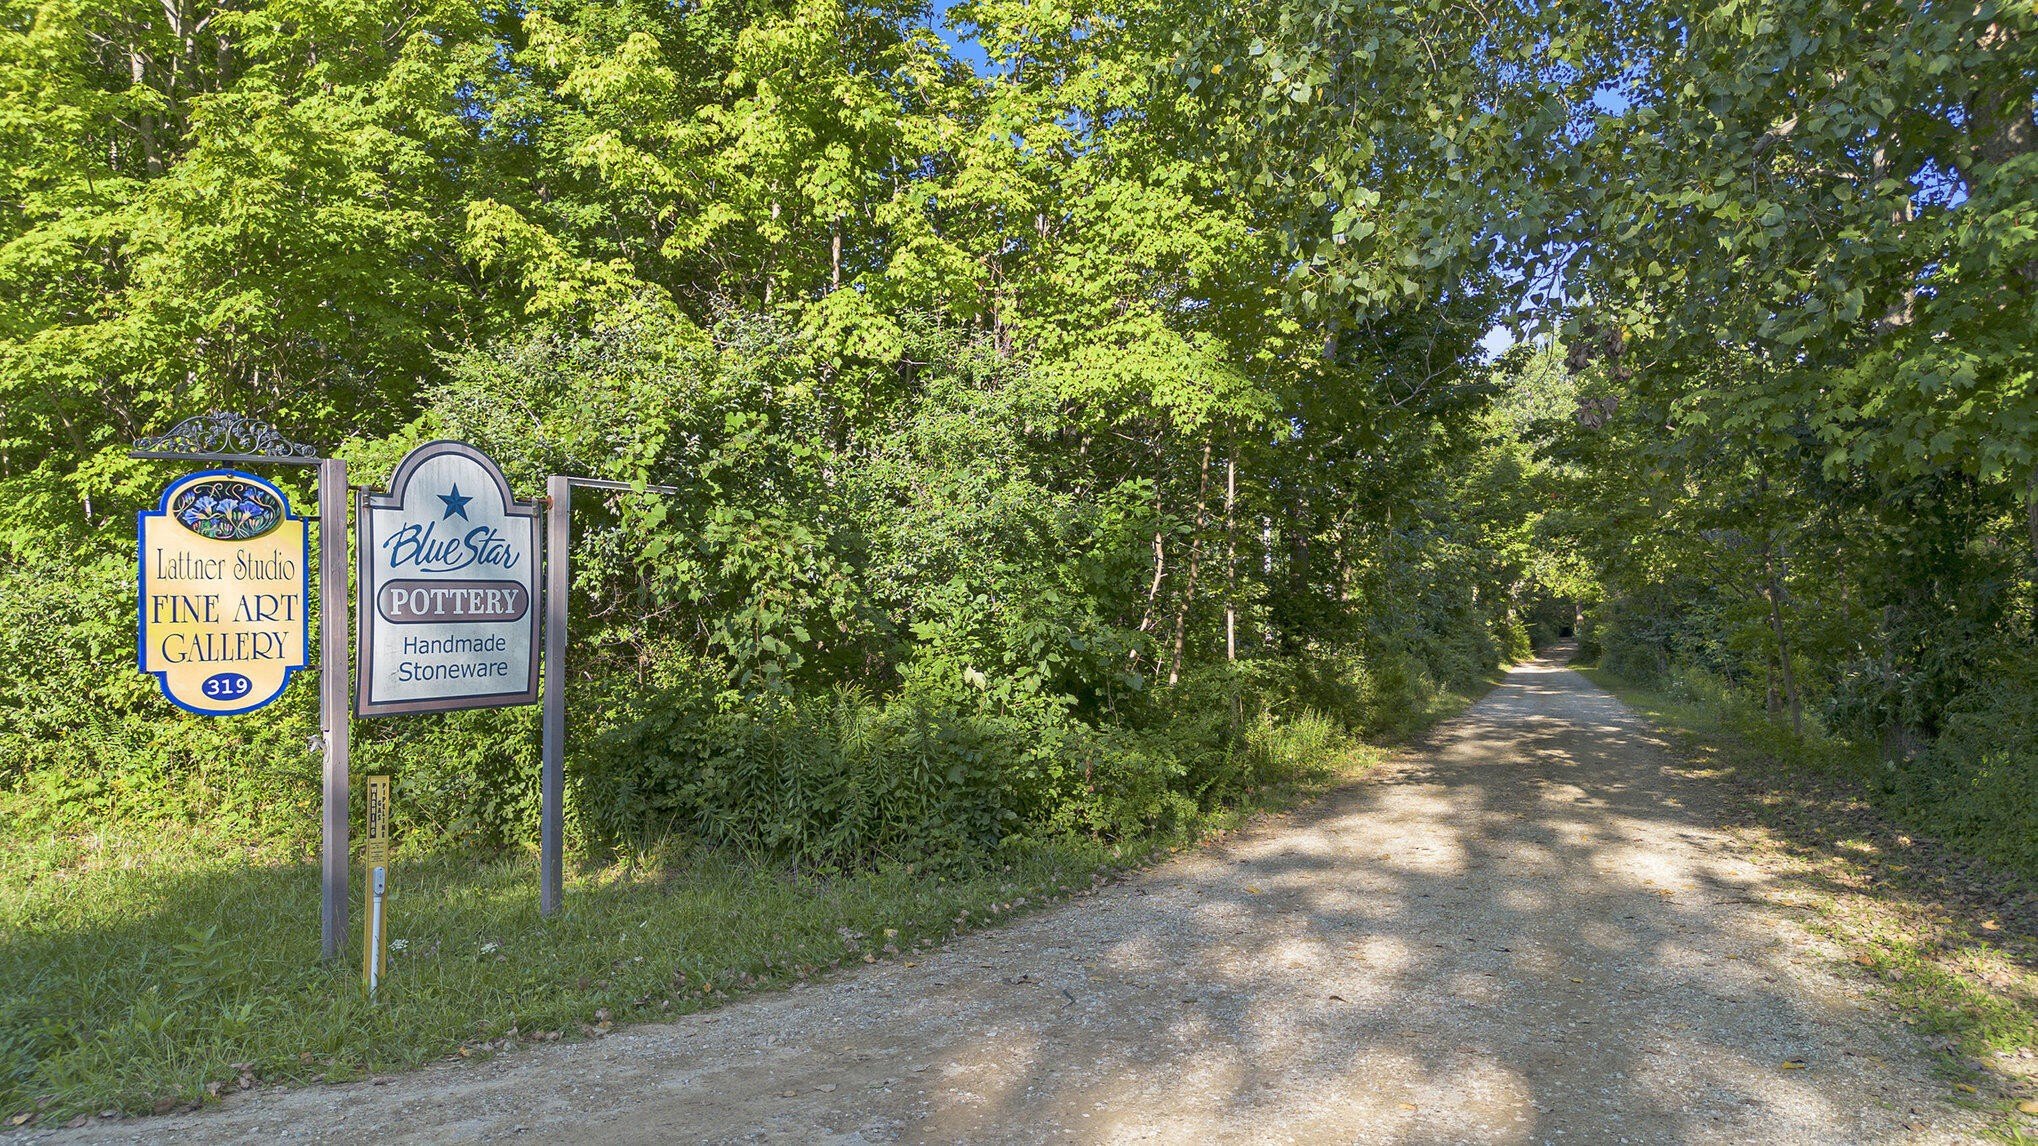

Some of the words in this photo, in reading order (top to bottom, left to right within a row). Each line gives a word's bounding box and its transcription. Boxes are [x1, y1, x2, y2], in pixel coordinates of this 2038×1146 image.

[157, 548, 226, 580] Lattner
[233, 548, 295, 580] Studio
[151, 594, 219, 624] FINE
[232, 593, 298, 622] ART
[391, 588, 519, 615] POTTERY
[162, 631, 289, 663] GALLERY
[404, 634, 506, 655] Handmade
[398, 660, 508, 682] Stoneware
[207, 677, 248, 696] 319
